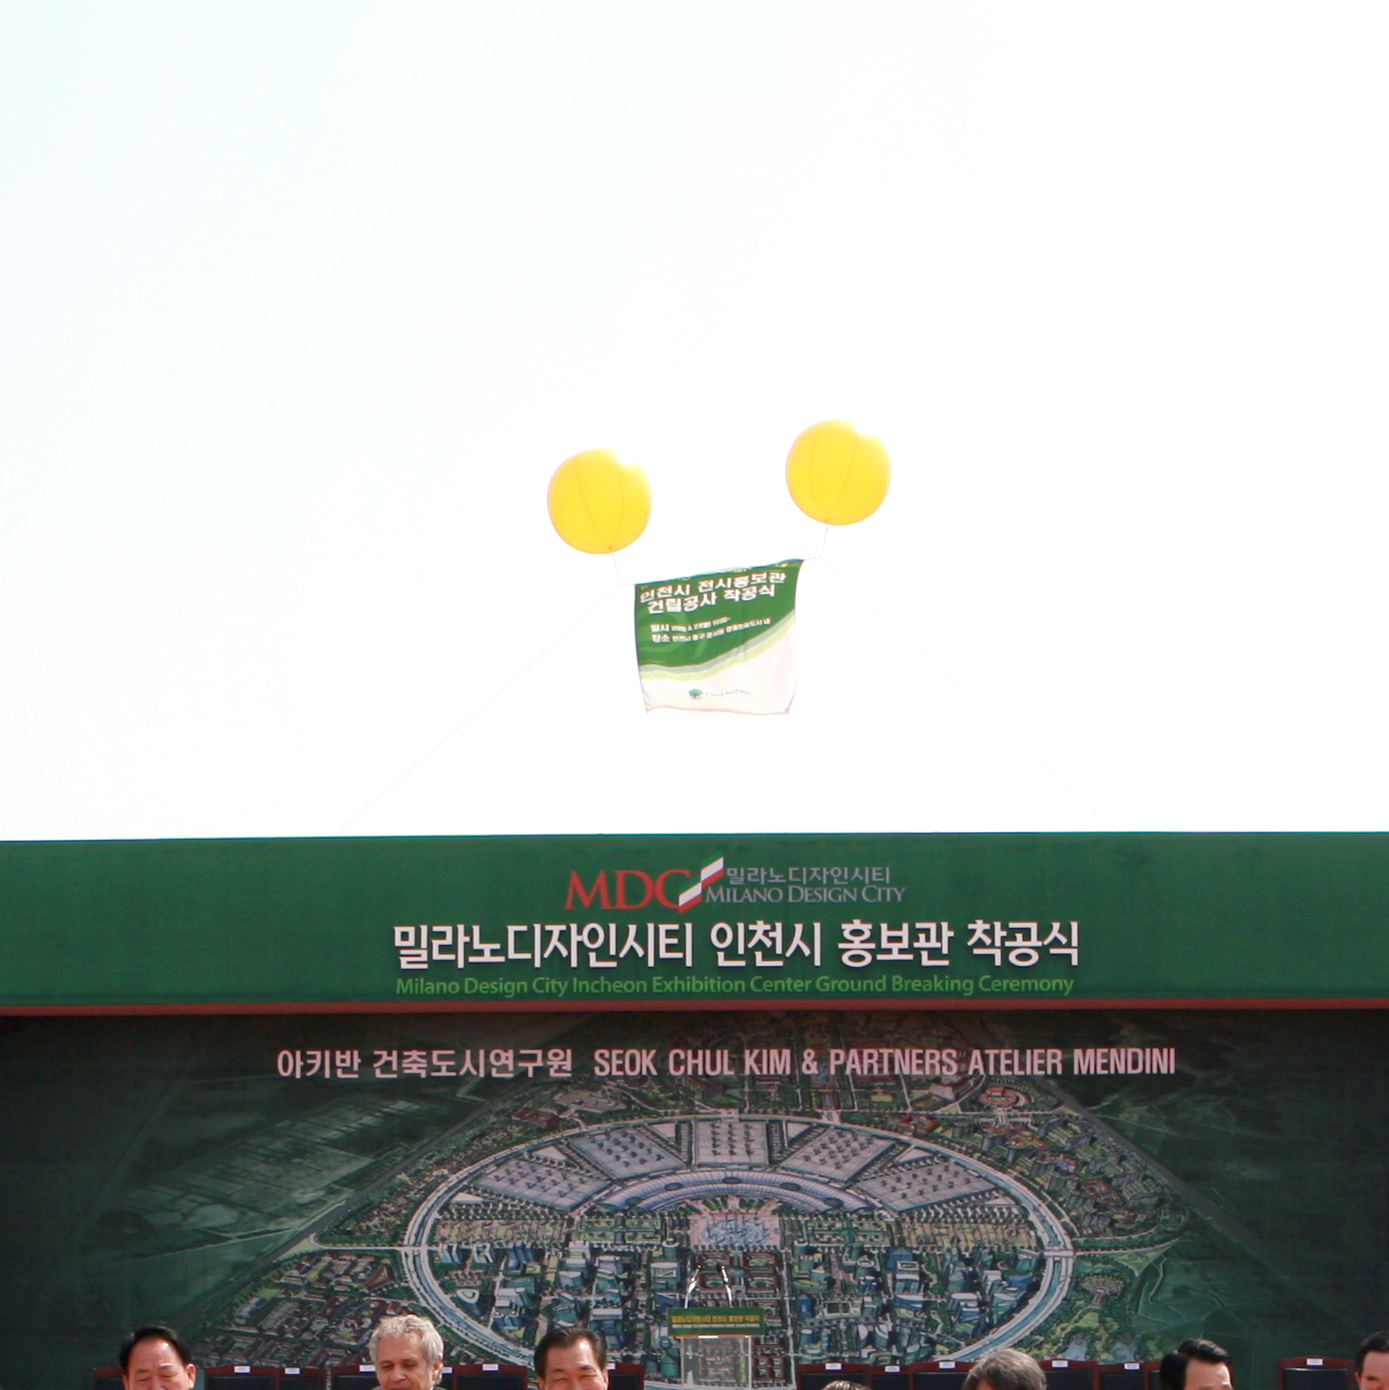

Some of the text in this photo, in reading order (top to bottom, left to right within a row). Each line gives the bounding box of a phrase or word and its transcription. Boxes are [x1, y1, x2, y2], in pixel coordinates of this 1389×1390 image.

[640, 571, 787, 603] 인천시 전시홍보관
[564, 868, 692, 910] MDC
[726, 866, 890, 886] 밀라노디자인시티
[705, 885, 906, 903] MILANO DESIGN CITY
[393, 918, 1079, 970] 밀라노디자인시티 인천시 홍보관 착공식
[396, 974, 1074, 998] Milano Design City Incheon Exhibition Center Ground Breaking Ceremony
[277, 1048, 573, 1079] 아키반 건축도시연구원
[594, 1047, 1176, 1076] SEOK CHUL KIM & PARTNERS ATELIER MENDINI
